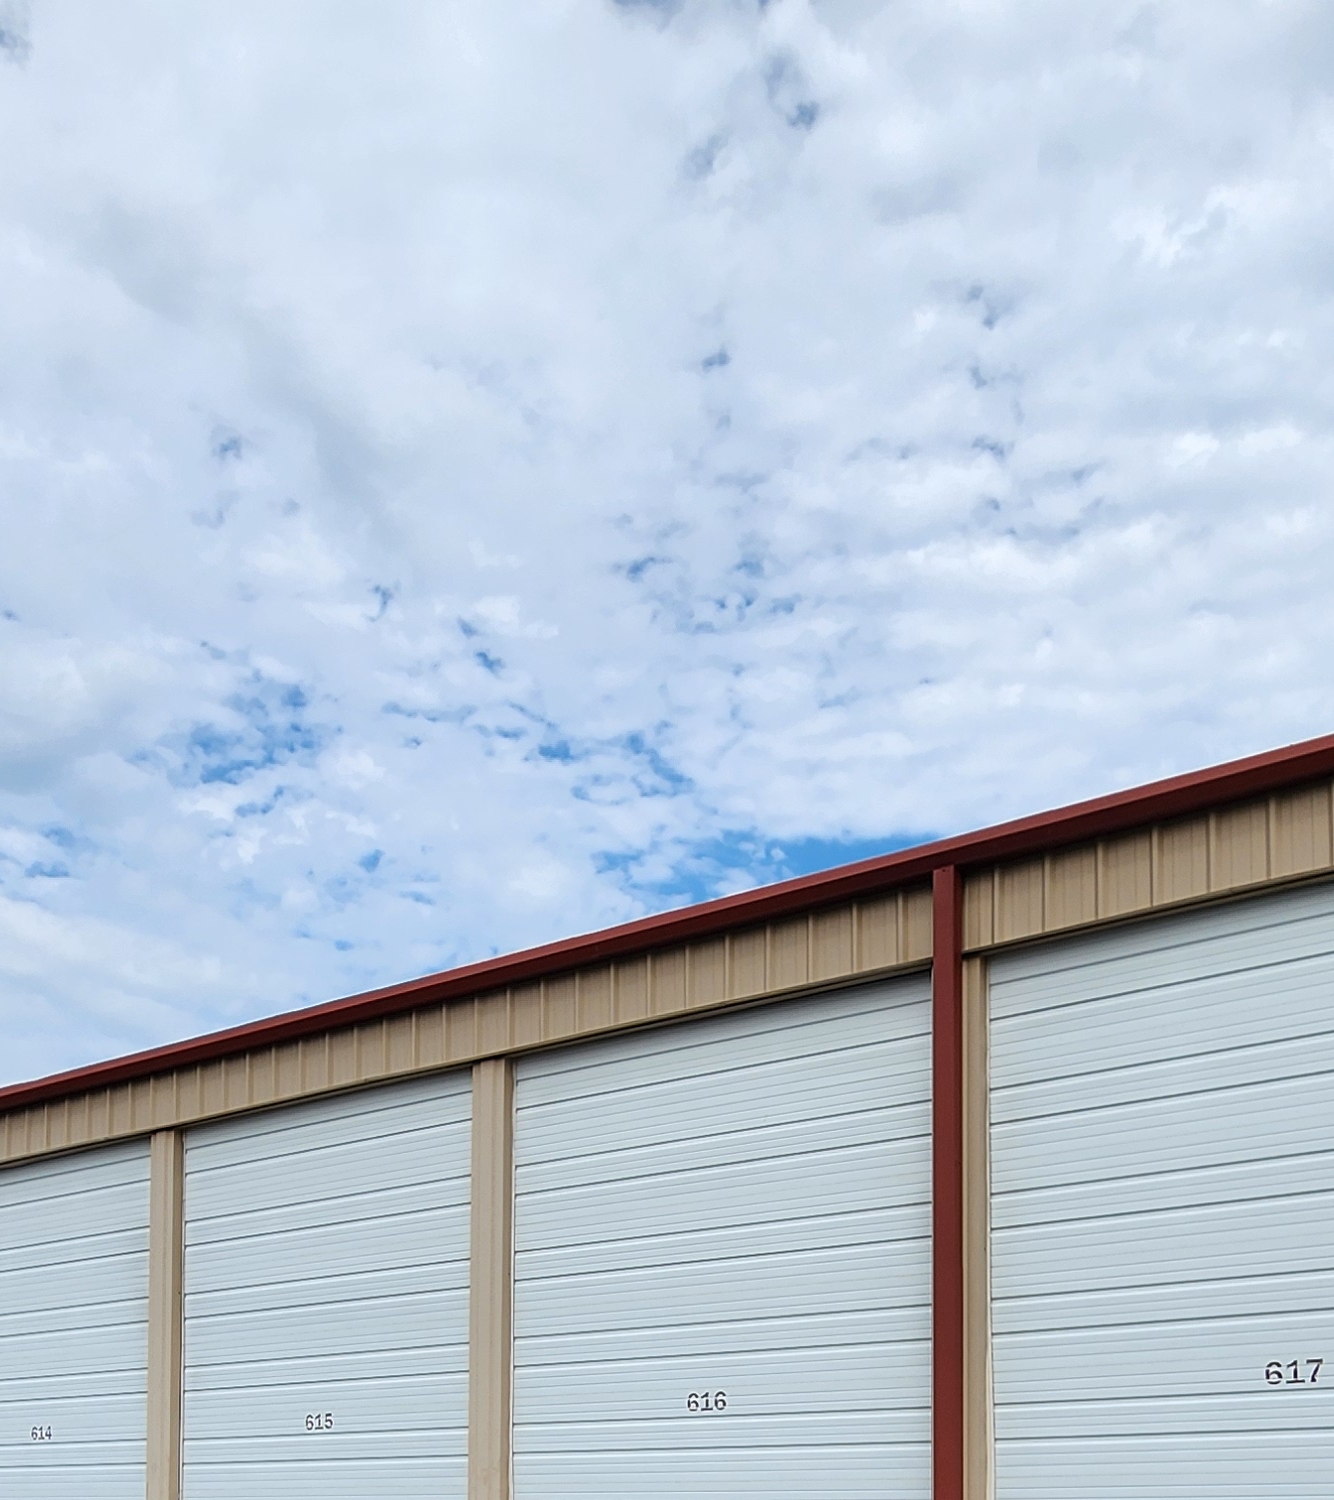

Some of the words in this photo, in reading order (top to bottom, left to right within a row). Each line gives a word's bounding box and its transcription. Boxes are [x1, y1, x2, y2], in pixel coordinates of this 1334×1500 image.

[1265, 1358, 1323, 1385] 617
[687, 1391, 727, 1412] 616
[305, 1413, 333, 1430] 615
[31, 1425, 52, 1440] 614
